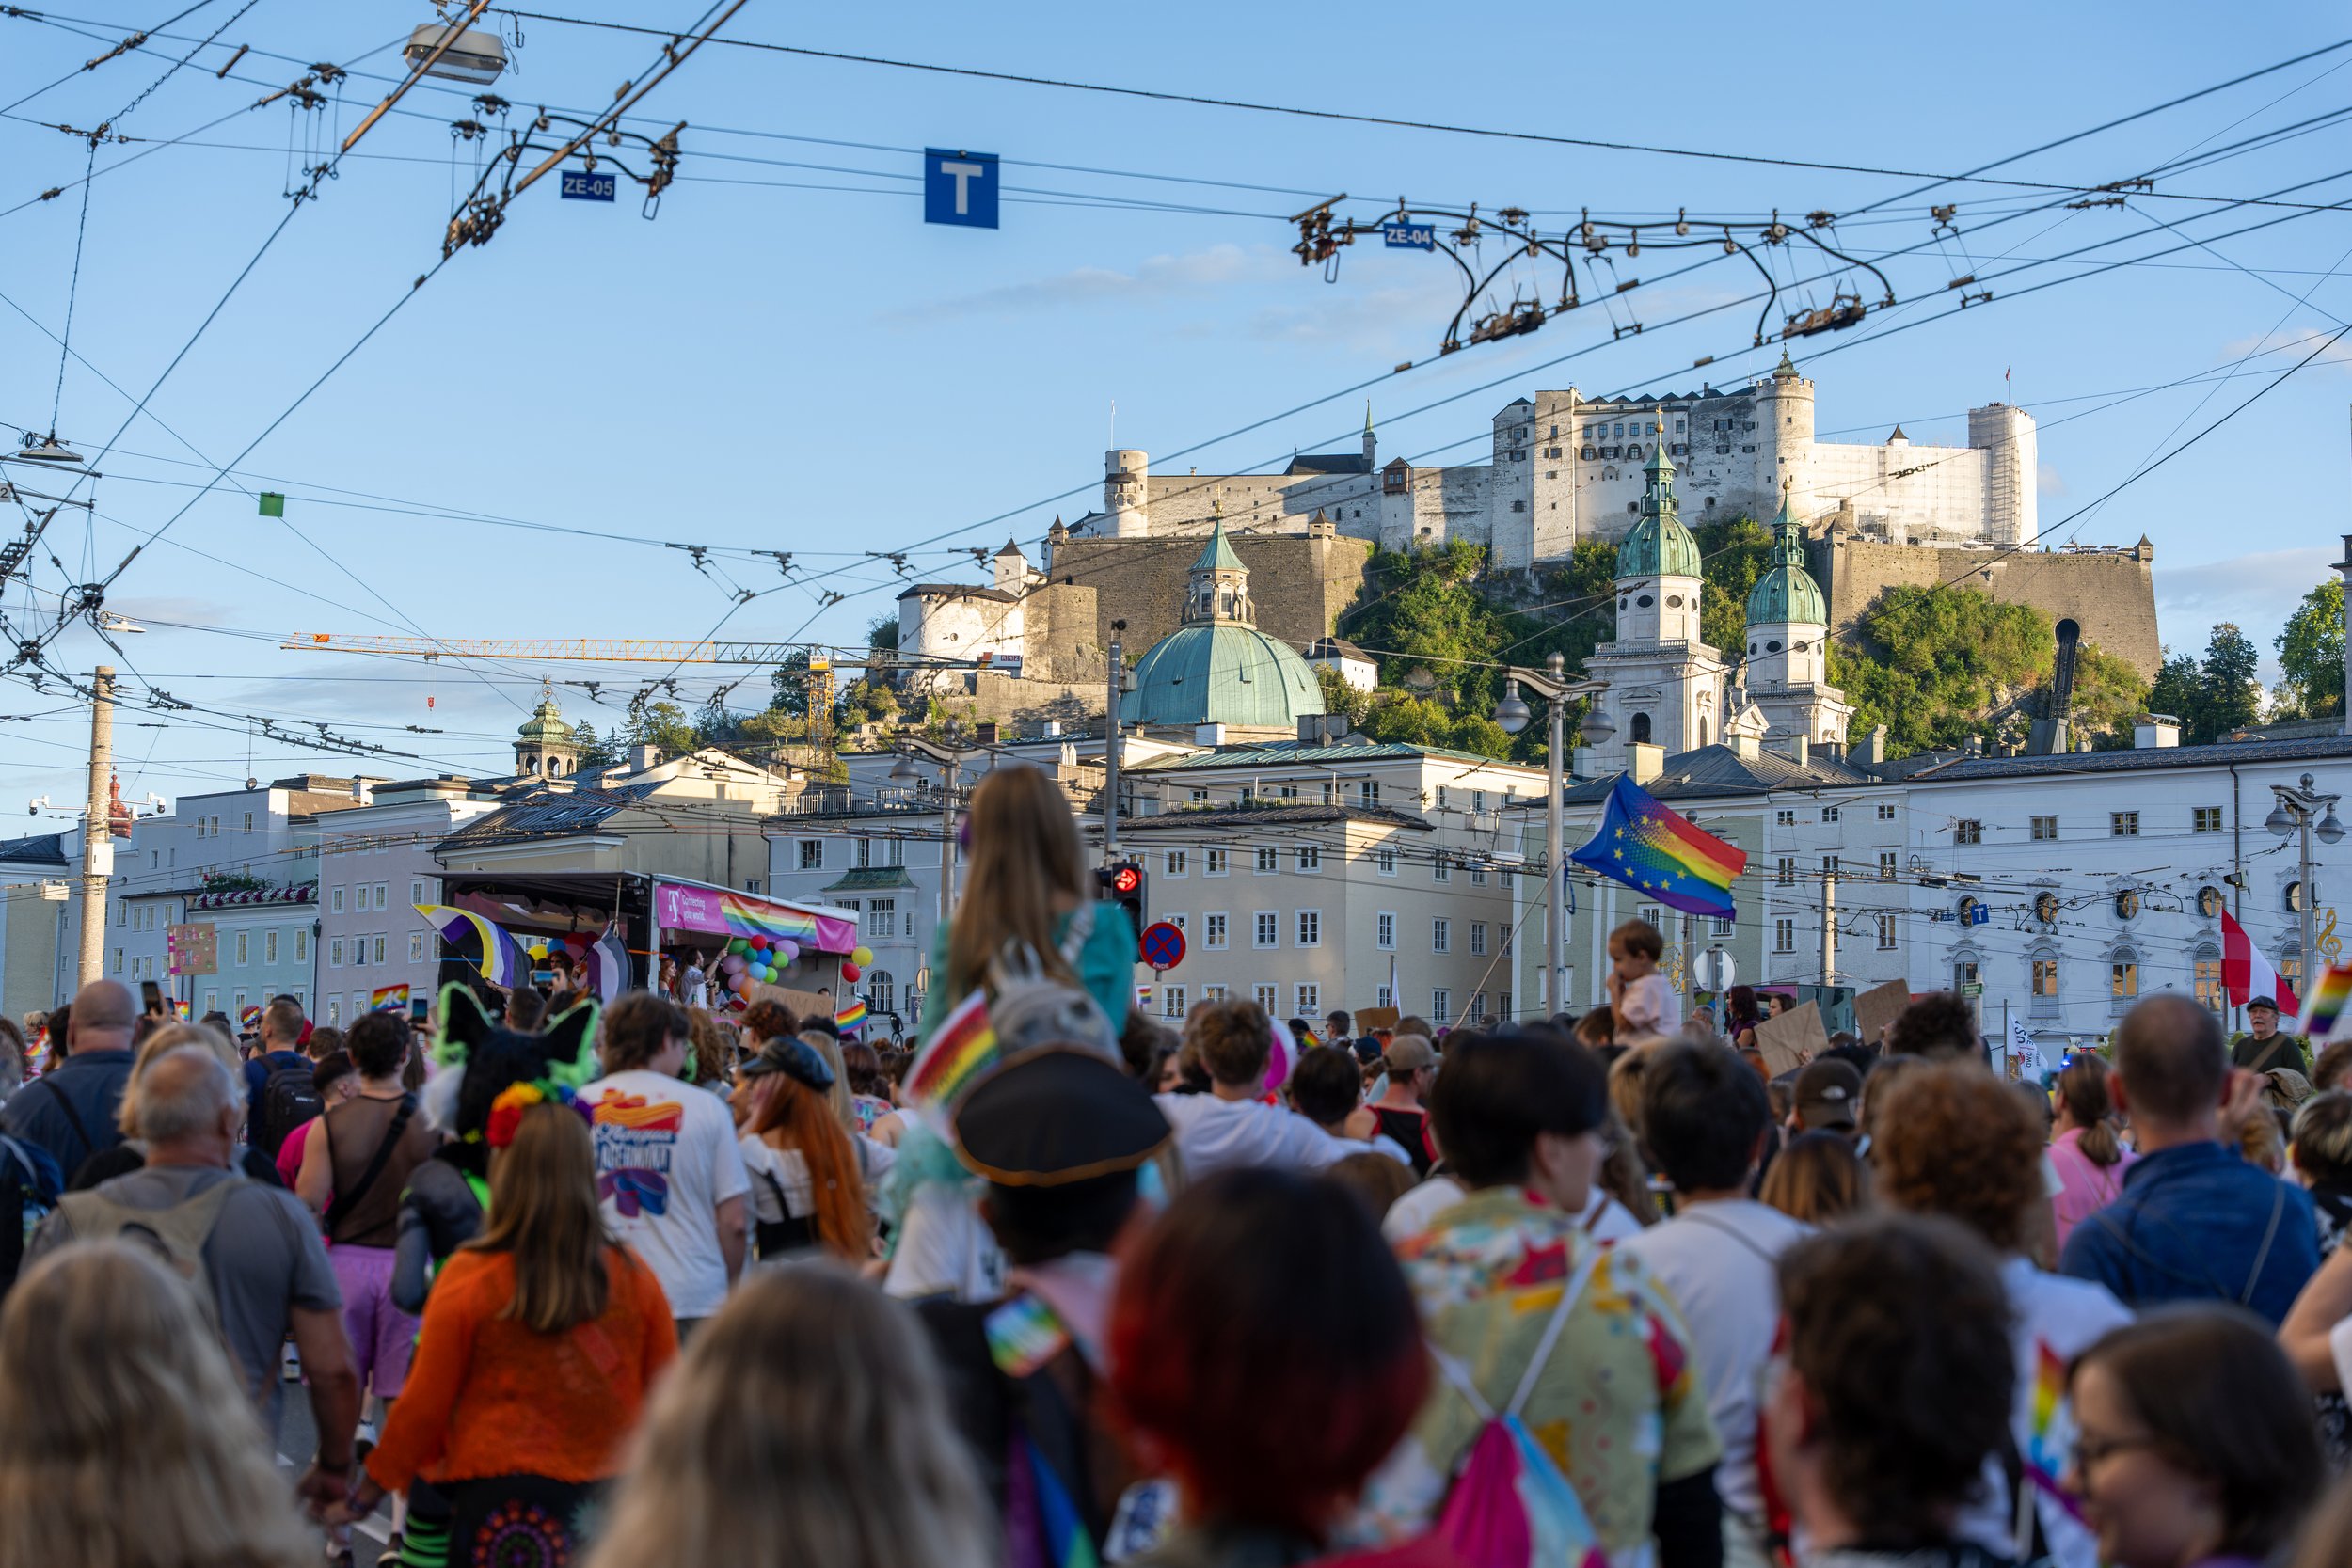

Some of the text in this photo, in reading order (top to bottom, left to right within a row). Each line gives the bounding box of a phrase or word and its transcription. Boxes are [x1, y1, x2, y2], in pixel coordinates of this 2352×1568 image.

[564, 178, 613, 197] ZE-05
[941, 161, 983, 215] T
[1386, 228, 1431, 245] ZE-04
[1974, 907, 1984, 922] T
[1152, 961, 1170, 970] ENDE
